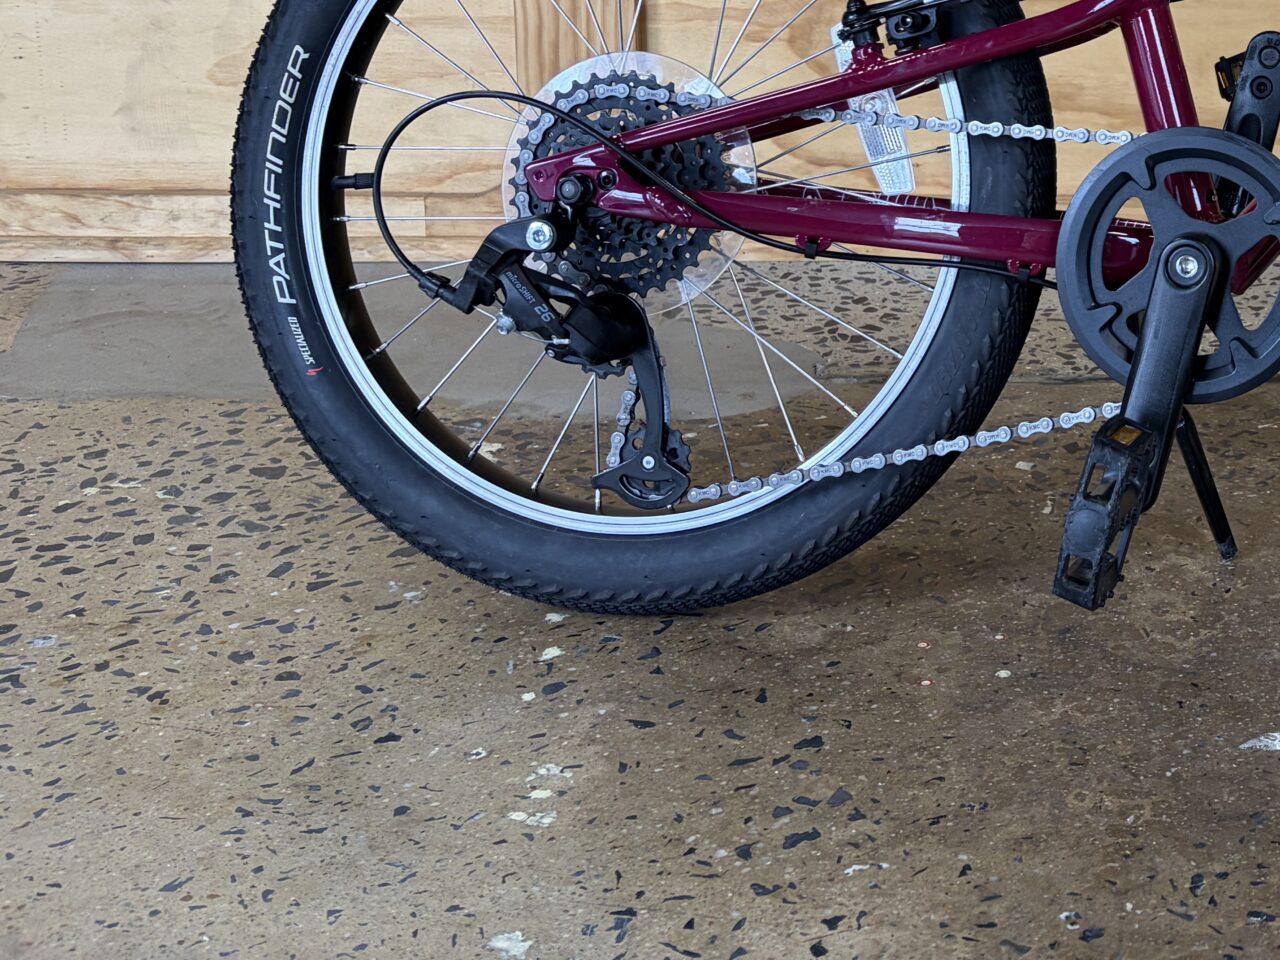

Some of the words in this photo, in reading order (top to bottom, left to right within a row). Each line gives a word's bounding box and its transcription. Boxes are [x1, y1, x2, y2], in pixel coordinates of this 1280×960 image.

[263, 44, 310, 304] PATHFINDER
[504, 270, 537, 305] microSHIFT
[534, 303, 556, 323] 26
[287, 316, 315, 366] SPECIALIZED
